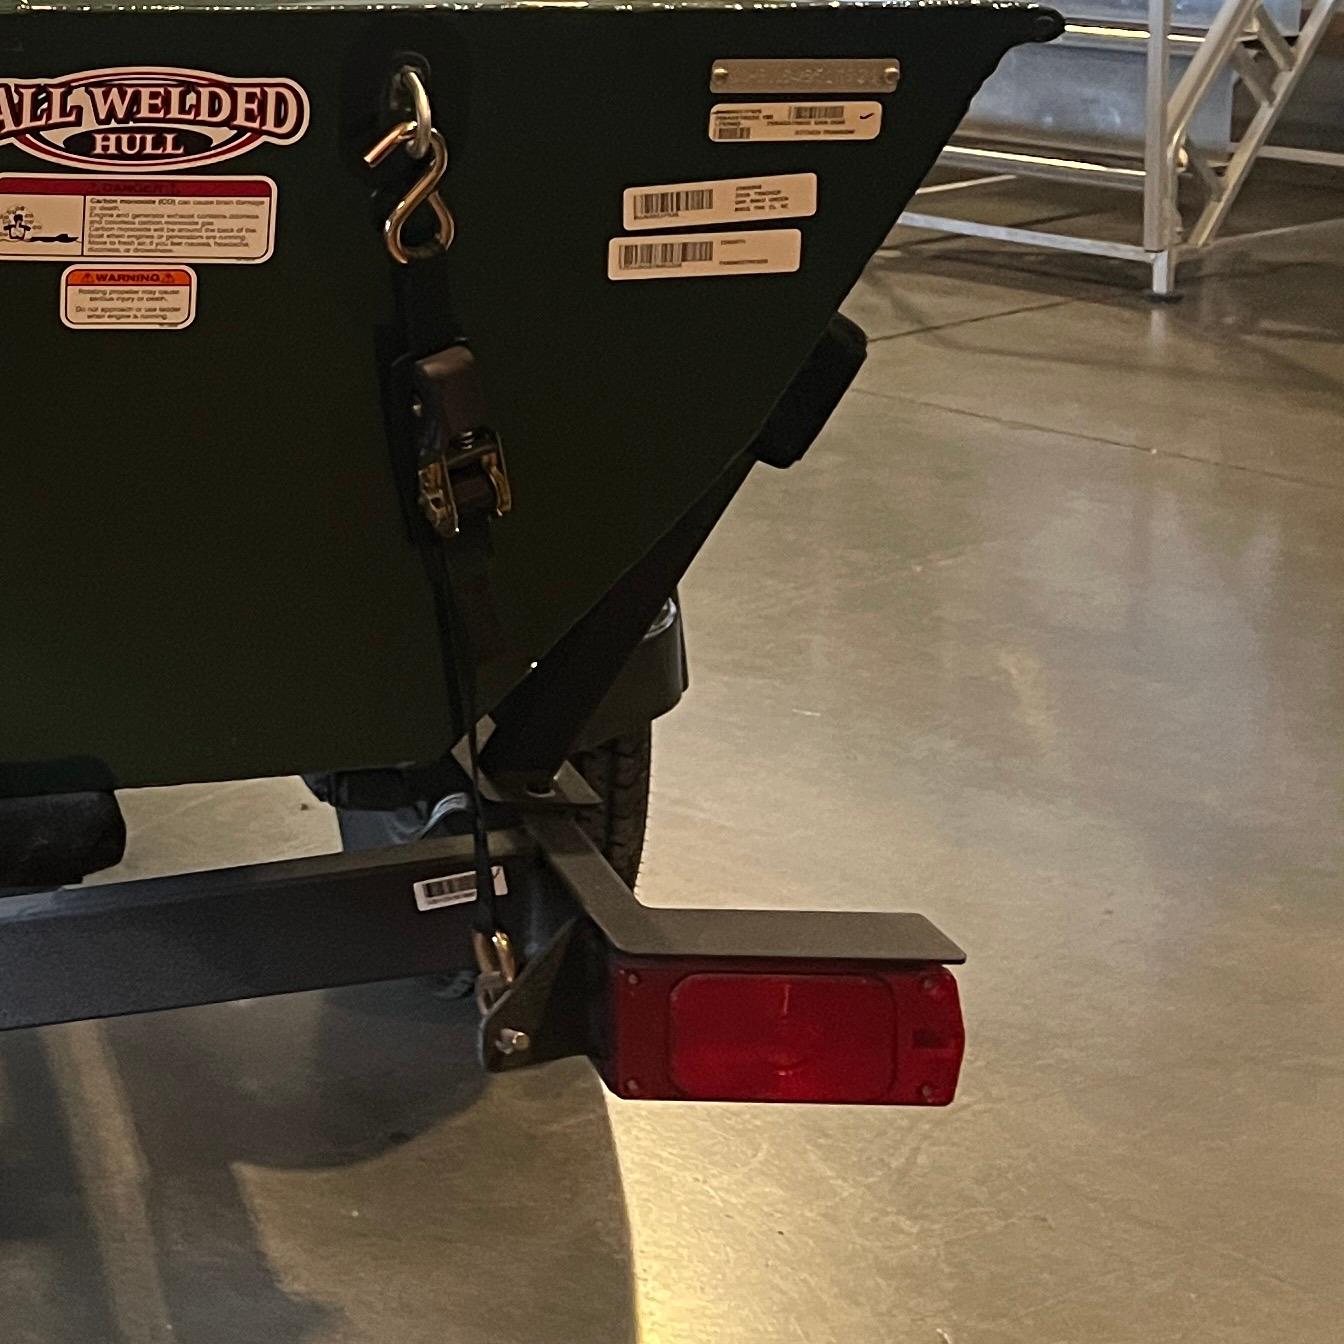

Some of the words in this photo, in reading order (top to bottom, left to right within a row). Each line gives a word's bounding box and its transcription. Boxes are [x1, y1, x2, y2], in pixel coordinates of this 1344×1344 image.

[89, 86, 298, 134] WELDED
[92, 132, 185, 155] HULL
[96, 273, 160, 282] WARNING
